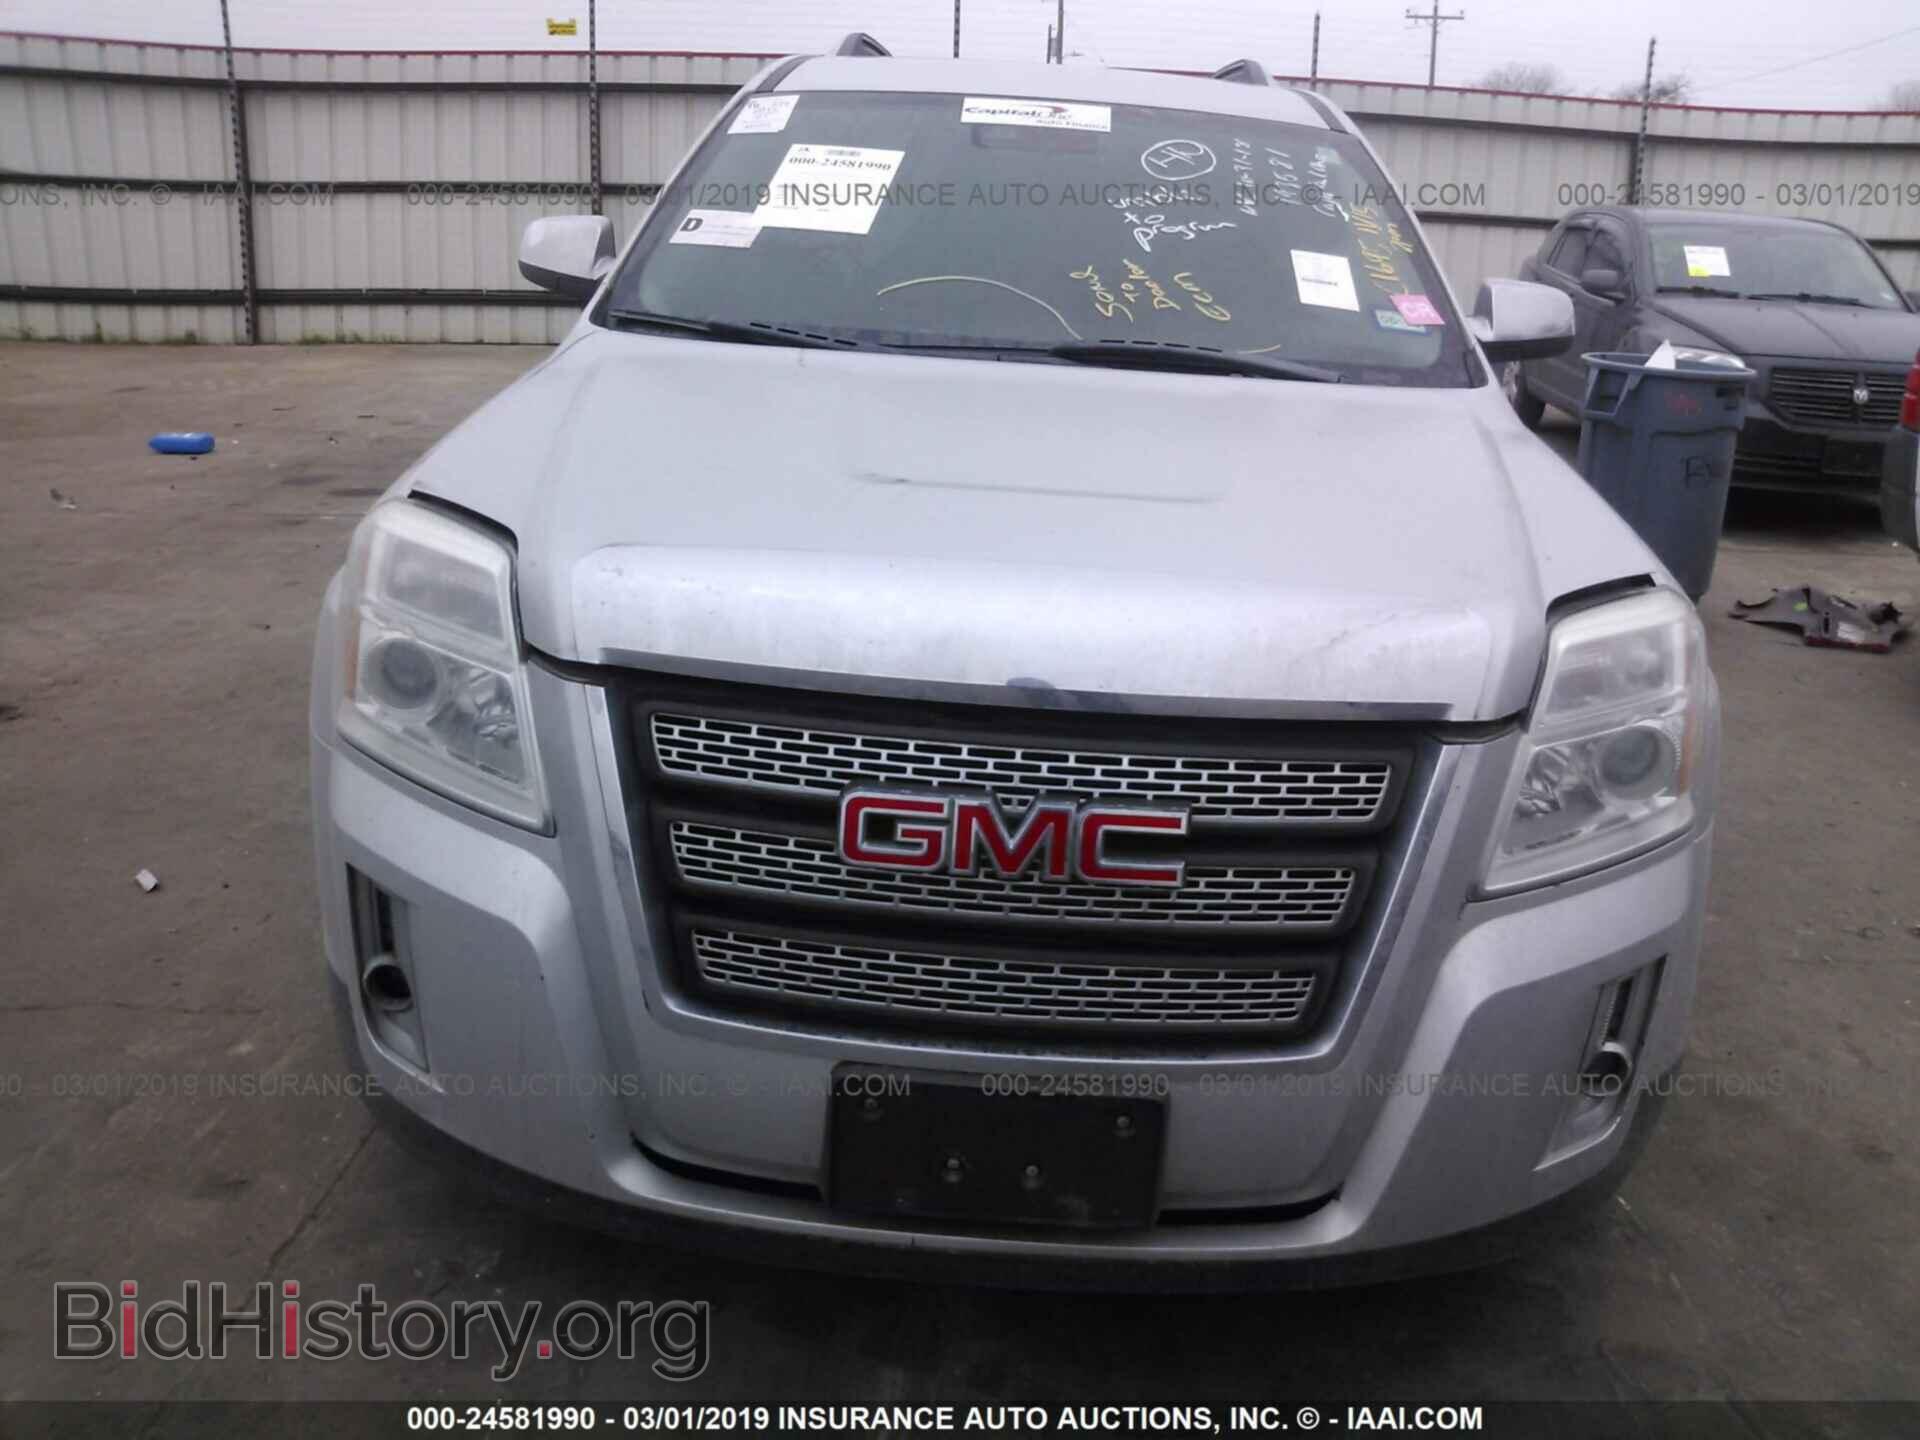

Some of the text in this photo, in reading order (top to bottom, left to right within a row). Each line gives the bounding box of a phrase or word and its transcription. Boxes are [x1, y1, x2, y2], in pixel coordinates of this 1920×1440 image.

[1066, 121, 1107, 129] Finance
[789, 155, 892, 172] 000-24581990
[679, 217, 704, 233] D
[840, 788, 1190, 888] GMC
